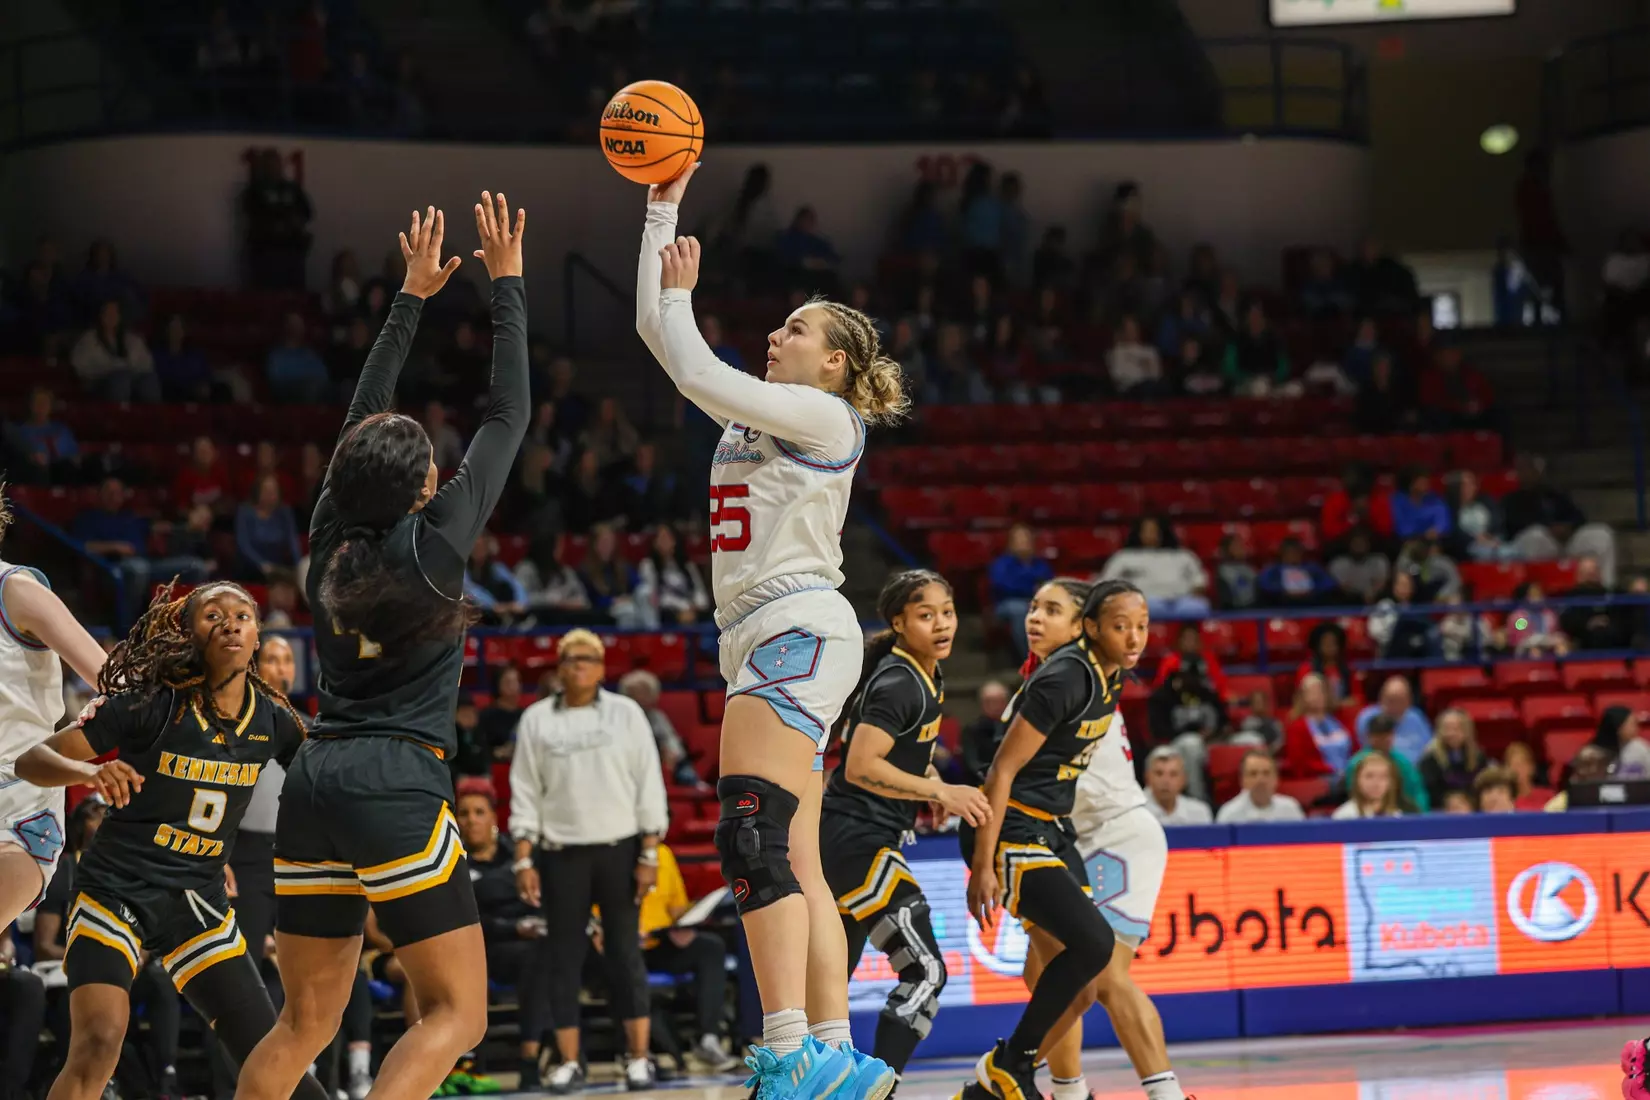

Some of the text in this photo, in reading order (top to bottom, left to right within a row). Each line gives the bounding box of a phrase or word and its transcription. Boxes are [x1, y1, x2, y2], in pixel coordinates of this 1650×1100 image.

[605, 137, 646, 155] NCAA
[156, 750, 262, 787] KENNESAW
[1135, 887, 1336, 958] ubota
